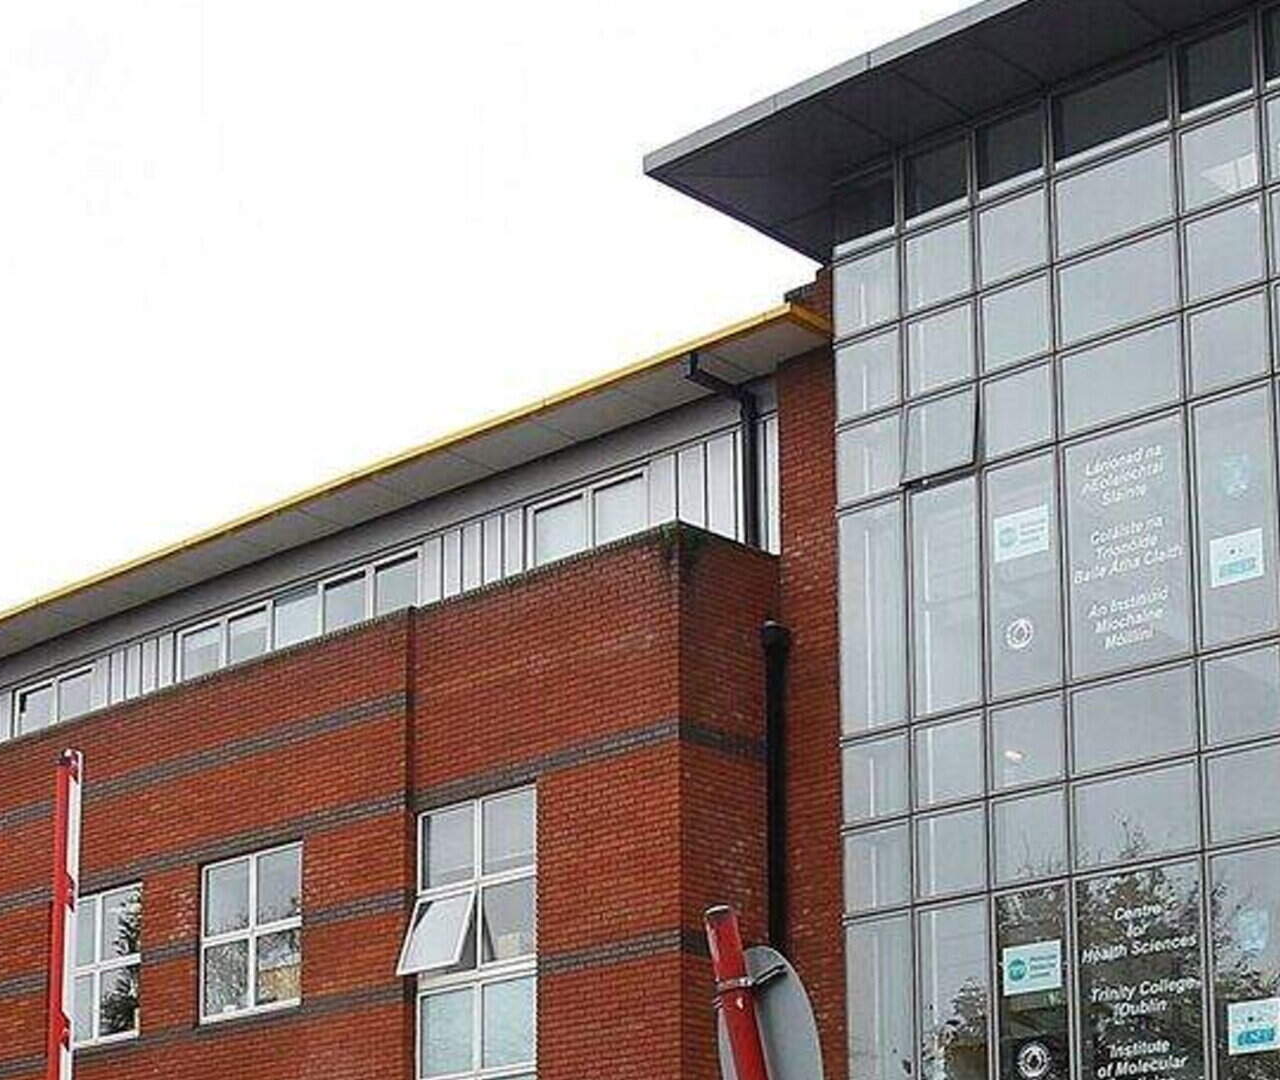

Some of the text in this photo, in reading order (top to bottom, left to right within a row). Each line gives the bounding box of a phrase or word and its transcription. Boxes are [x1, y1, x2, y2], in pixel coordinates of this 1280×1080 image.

[1114, 905, 1163, 921] Centre
[1082, 935, 1197, 964] Health Sciences
[1091, 978, 1198, 1003] Trinity College
[1120, 1000, 1167, 1017] Dublin
[1109, 1040, 1170, 1059] Institute
[1097, 1055, 1188, 1079] of Molecular
